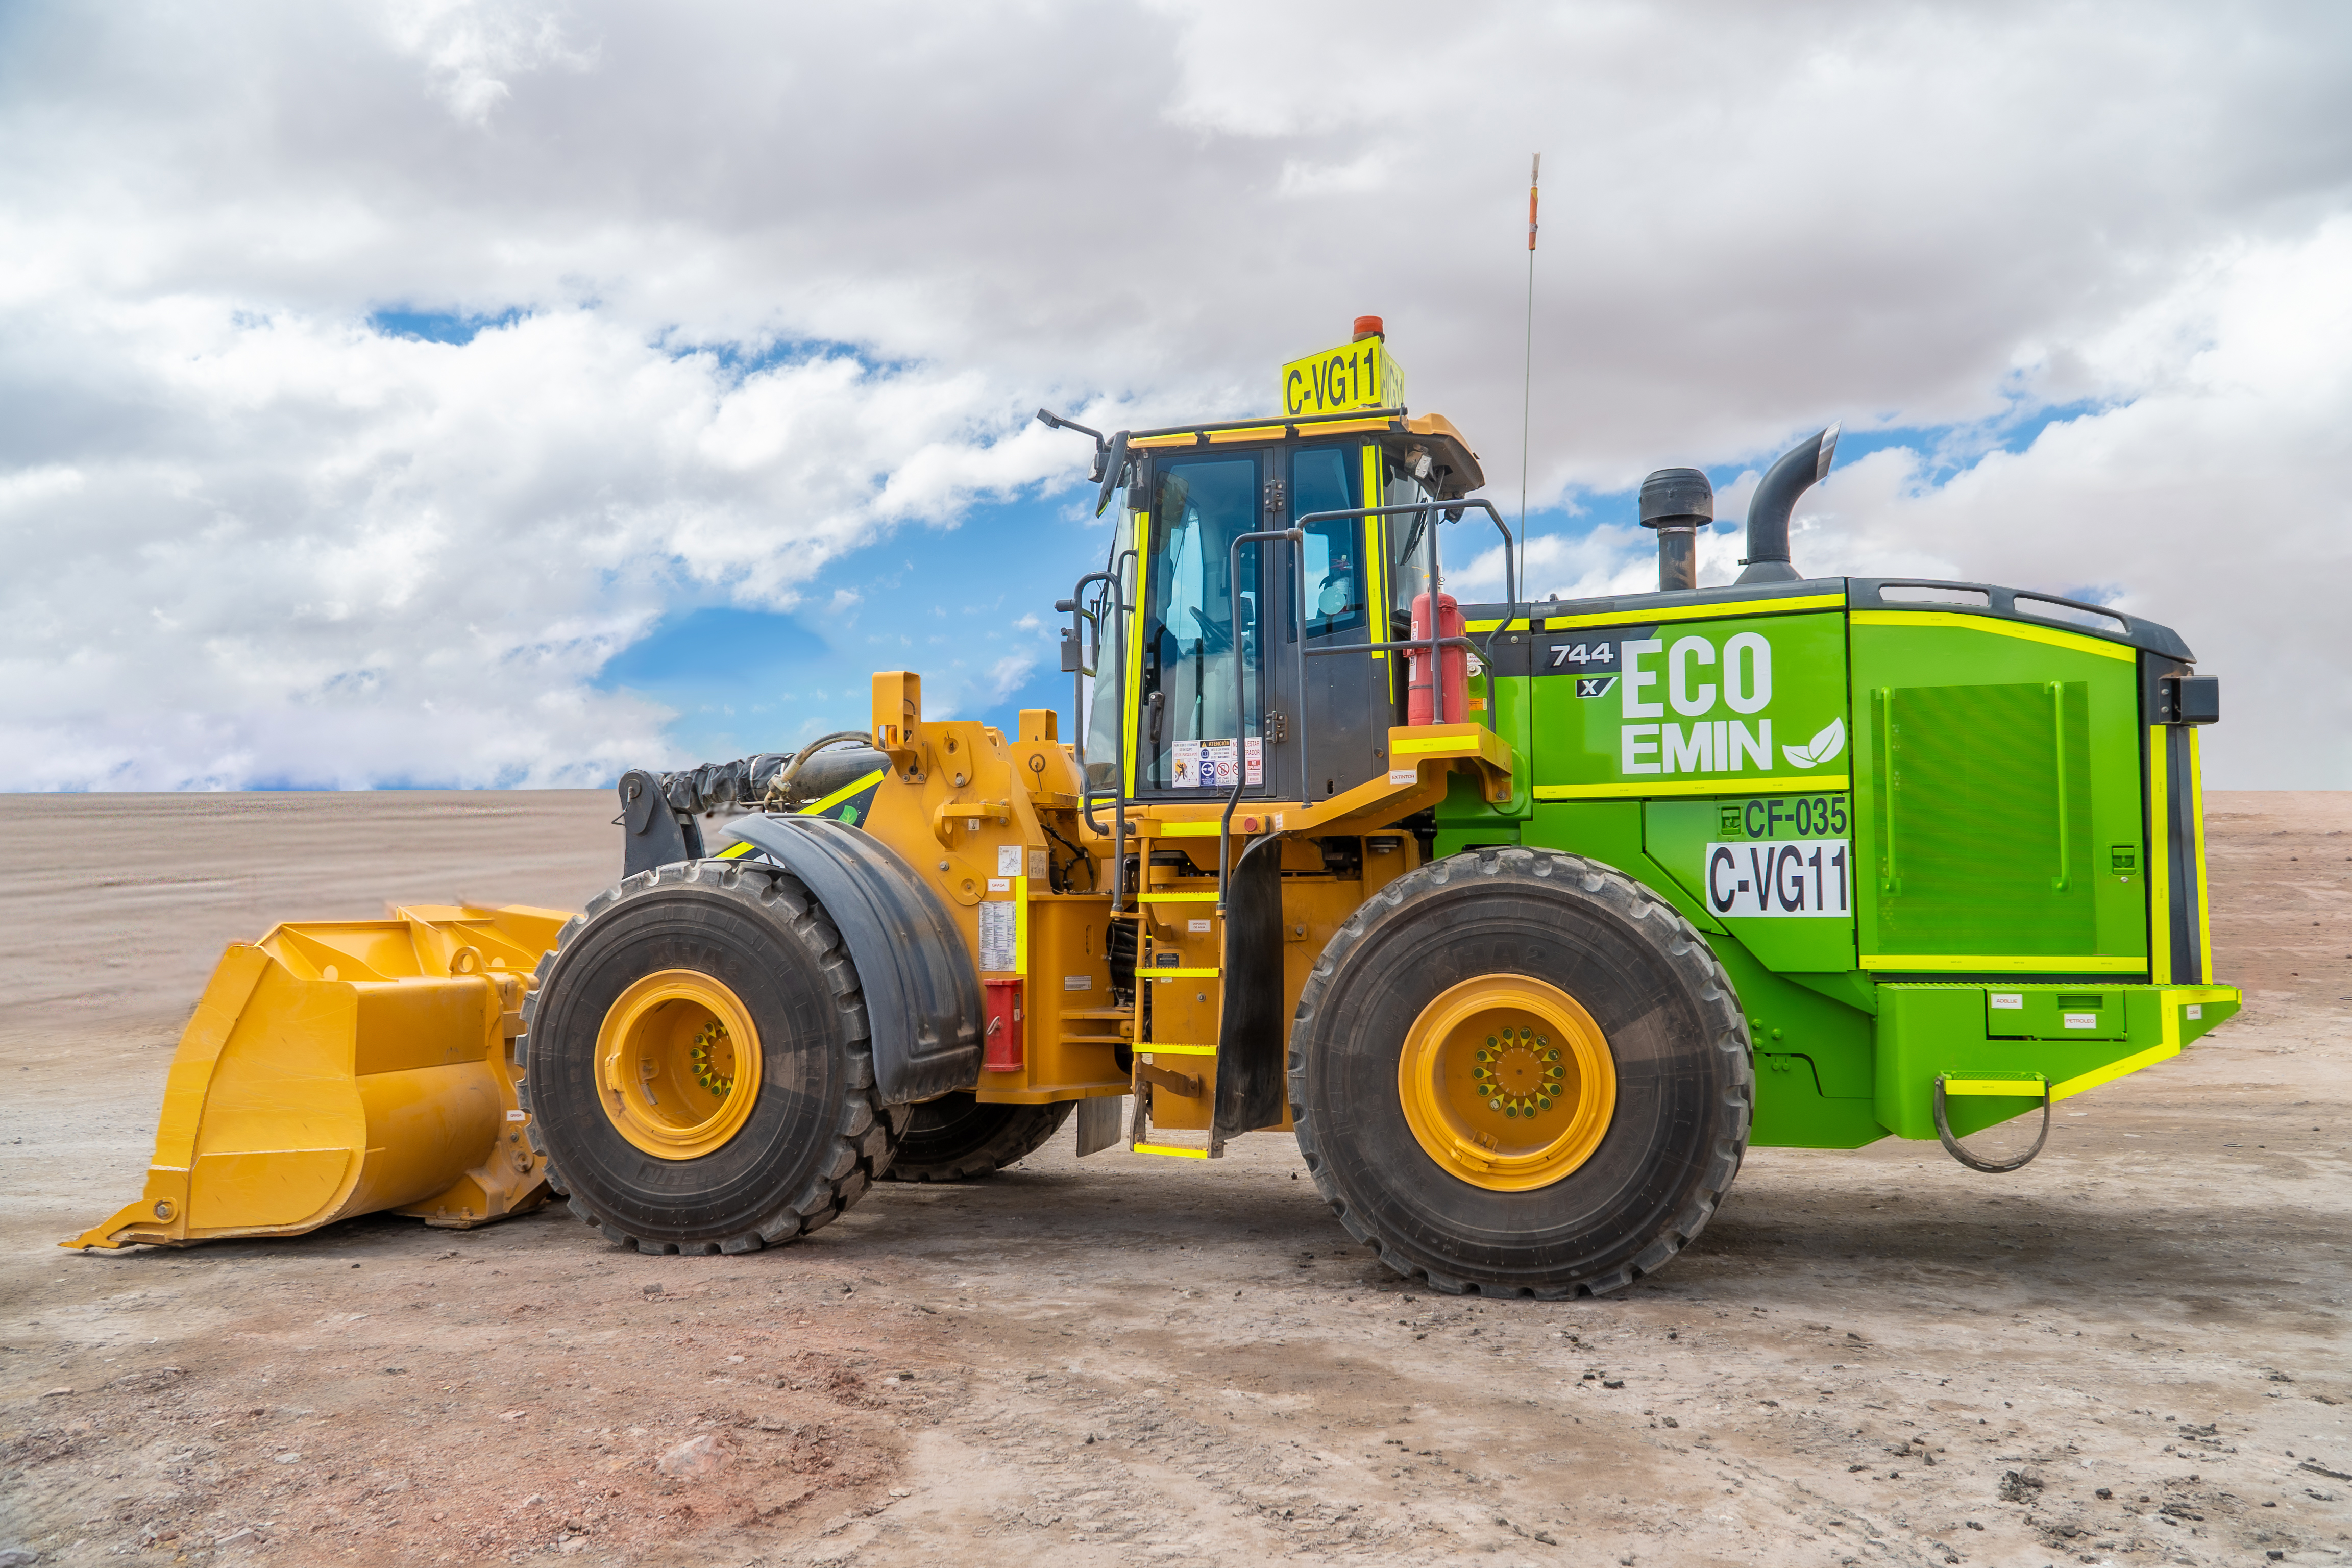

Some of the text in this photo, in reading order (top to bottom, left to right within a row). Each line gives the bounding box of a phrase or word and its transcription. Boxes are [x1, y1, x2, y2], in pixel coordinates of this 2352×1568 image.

[1287, 347, 1375, 415] C-VG11
[1550, 642, 1614, 666] 744
[1621, 631, 1772, 719] ECO
[1621, 719, 1773, 775] EMIN
[1745, 797, 1848, 838] CF-035
[1710, 845, 1847, 913] C-VG11
